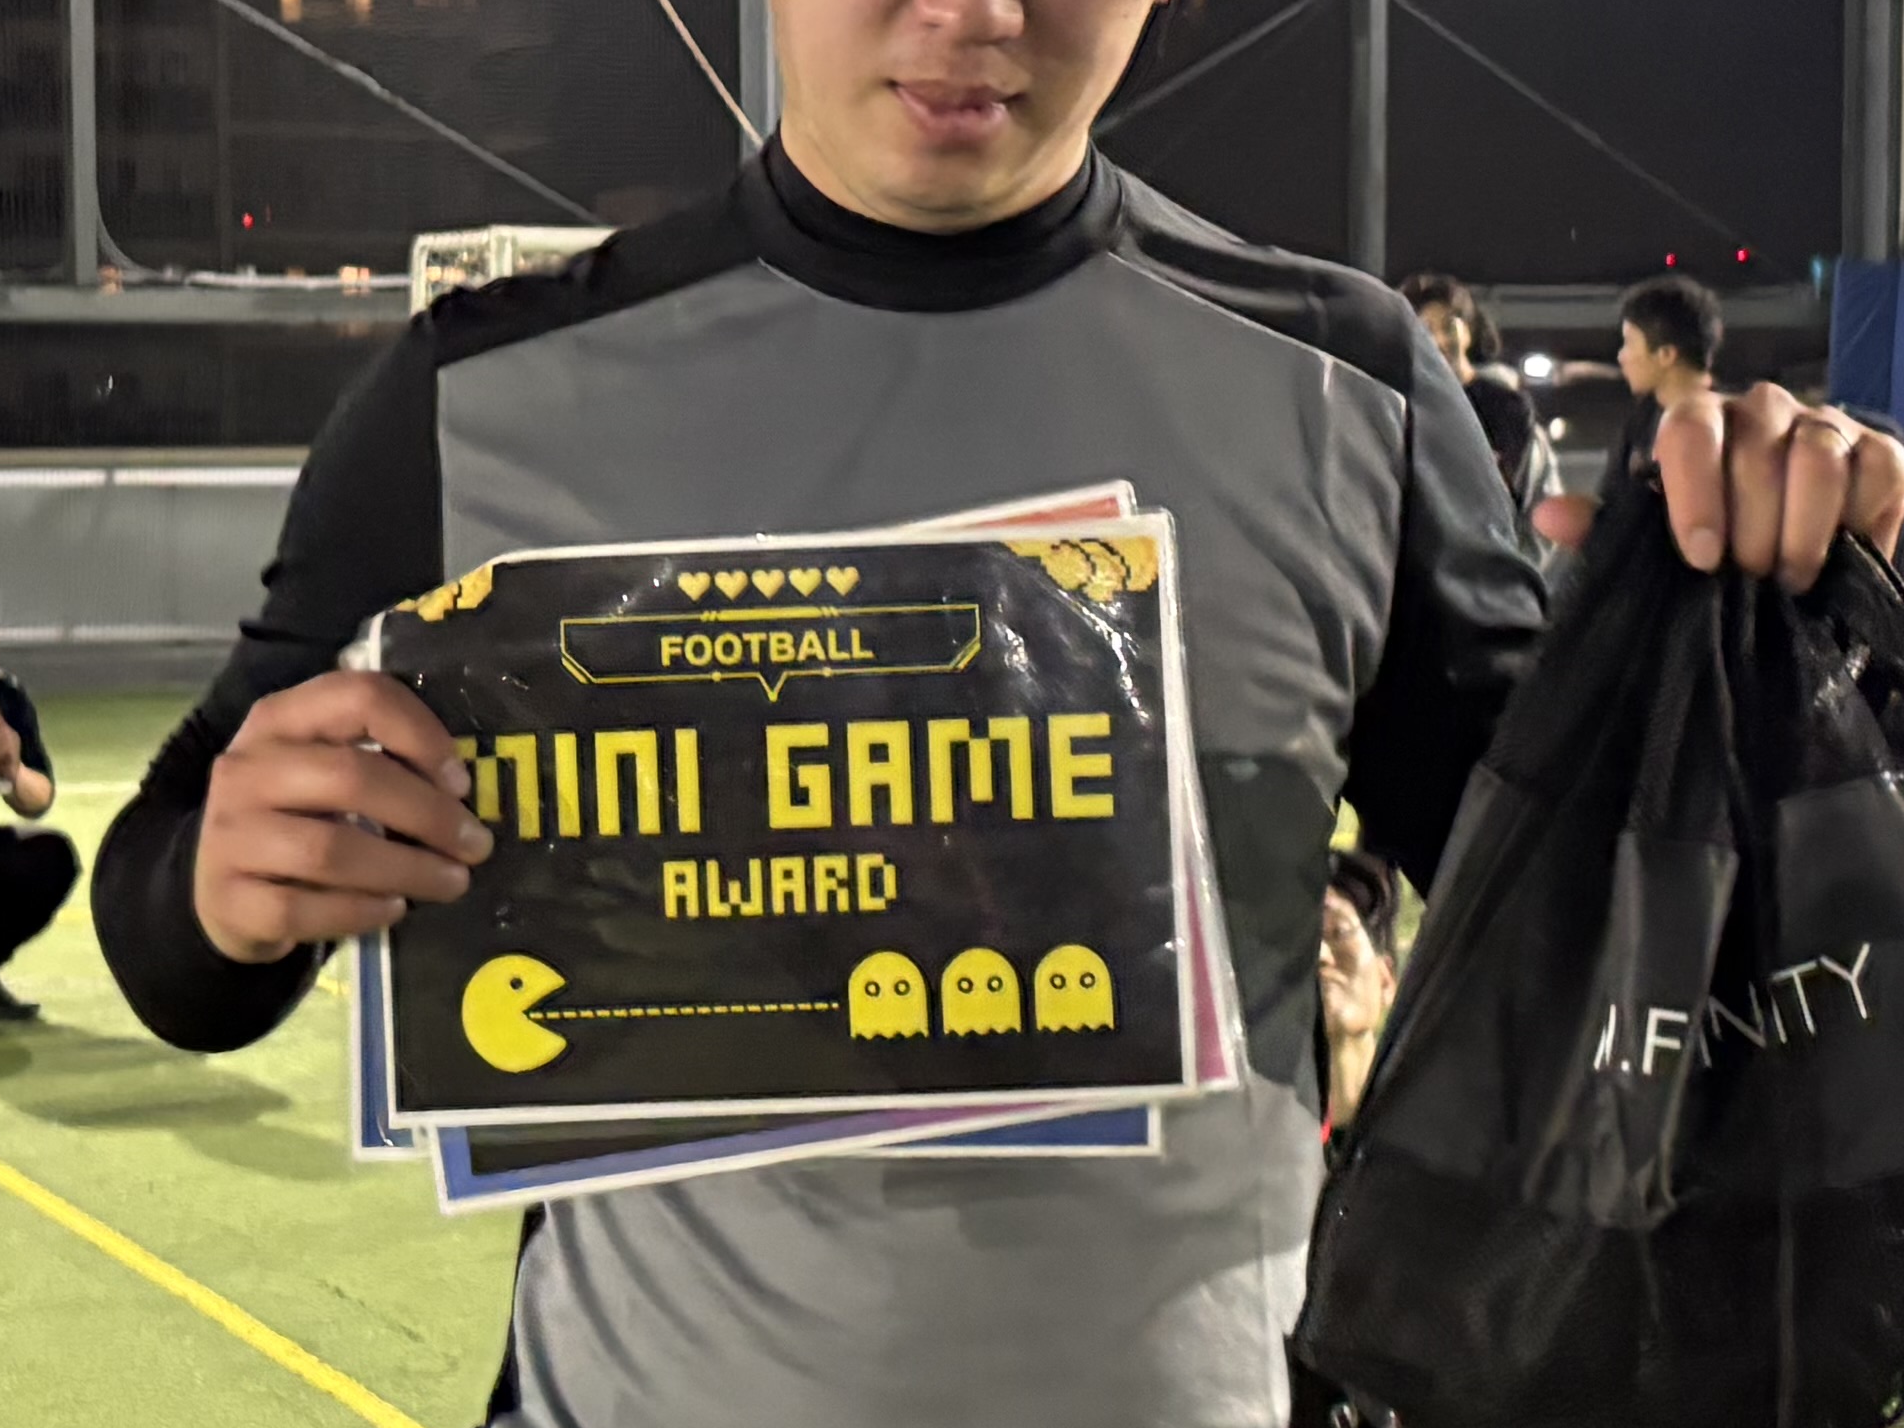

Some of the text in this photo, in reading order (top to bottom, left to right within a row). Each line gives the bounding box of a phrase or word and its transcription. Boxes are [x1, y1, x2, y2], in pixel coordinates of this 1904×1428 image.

[660, 628, 874, 668] FOOTBALL
[765, 713, 1114, 829] GAME
[662, 854, 897, 918] AWARD
